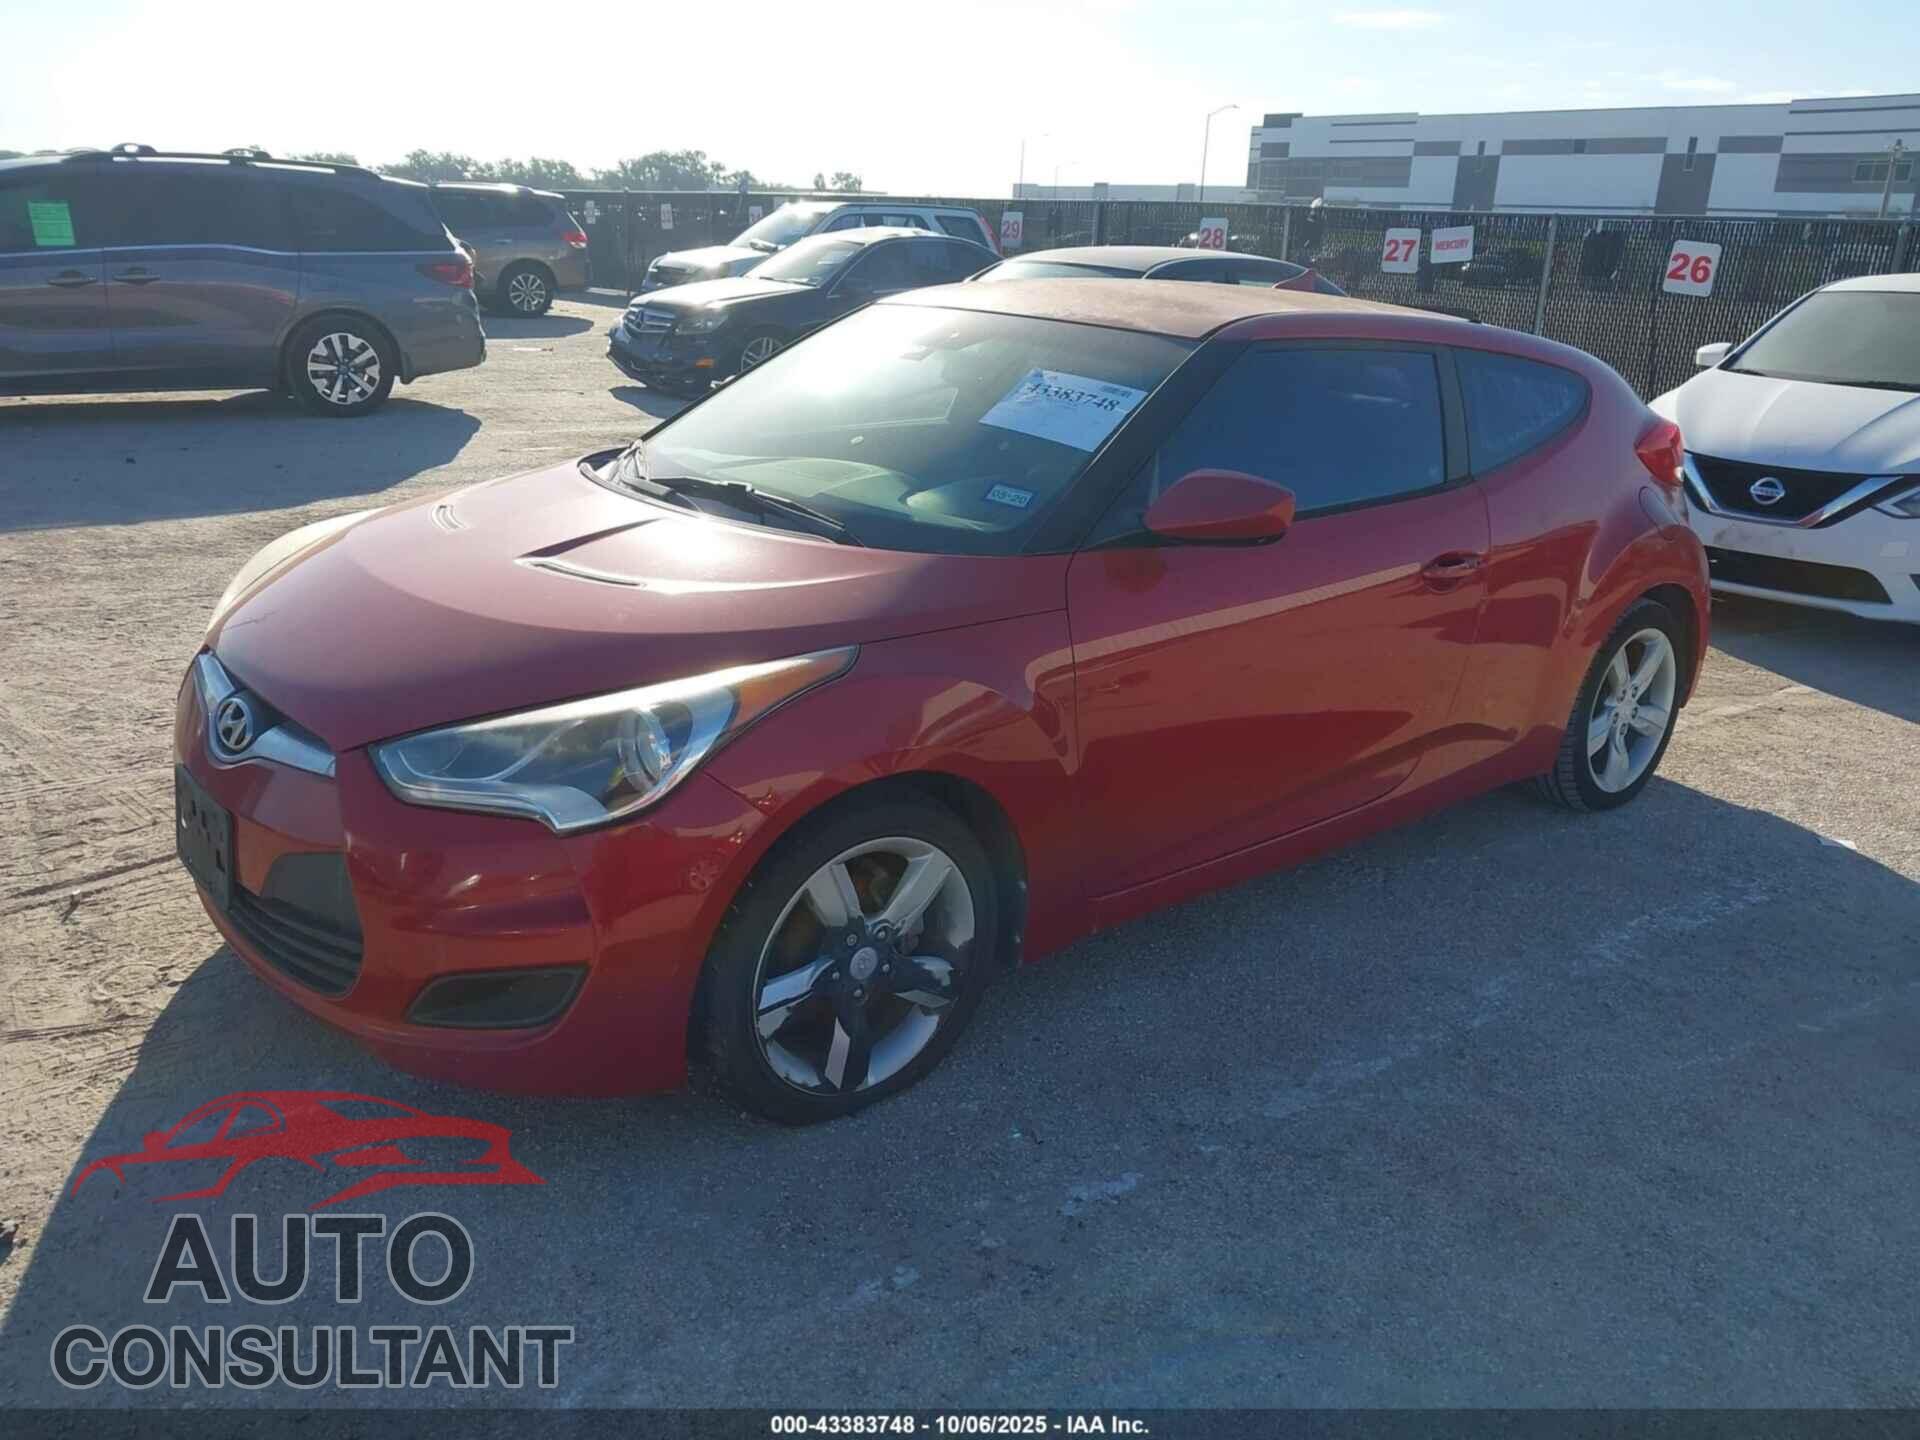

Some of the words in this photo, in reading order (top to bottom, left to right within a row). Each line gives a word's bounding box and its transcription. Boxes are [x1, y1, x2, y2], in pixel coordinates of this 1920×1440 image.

[1003, 220, 1020, 240] 29
[1199, 227, 1225, 249] 28
[1384, 239, 1416, 262] 27
[1667, 253, 1712, 284] 26
